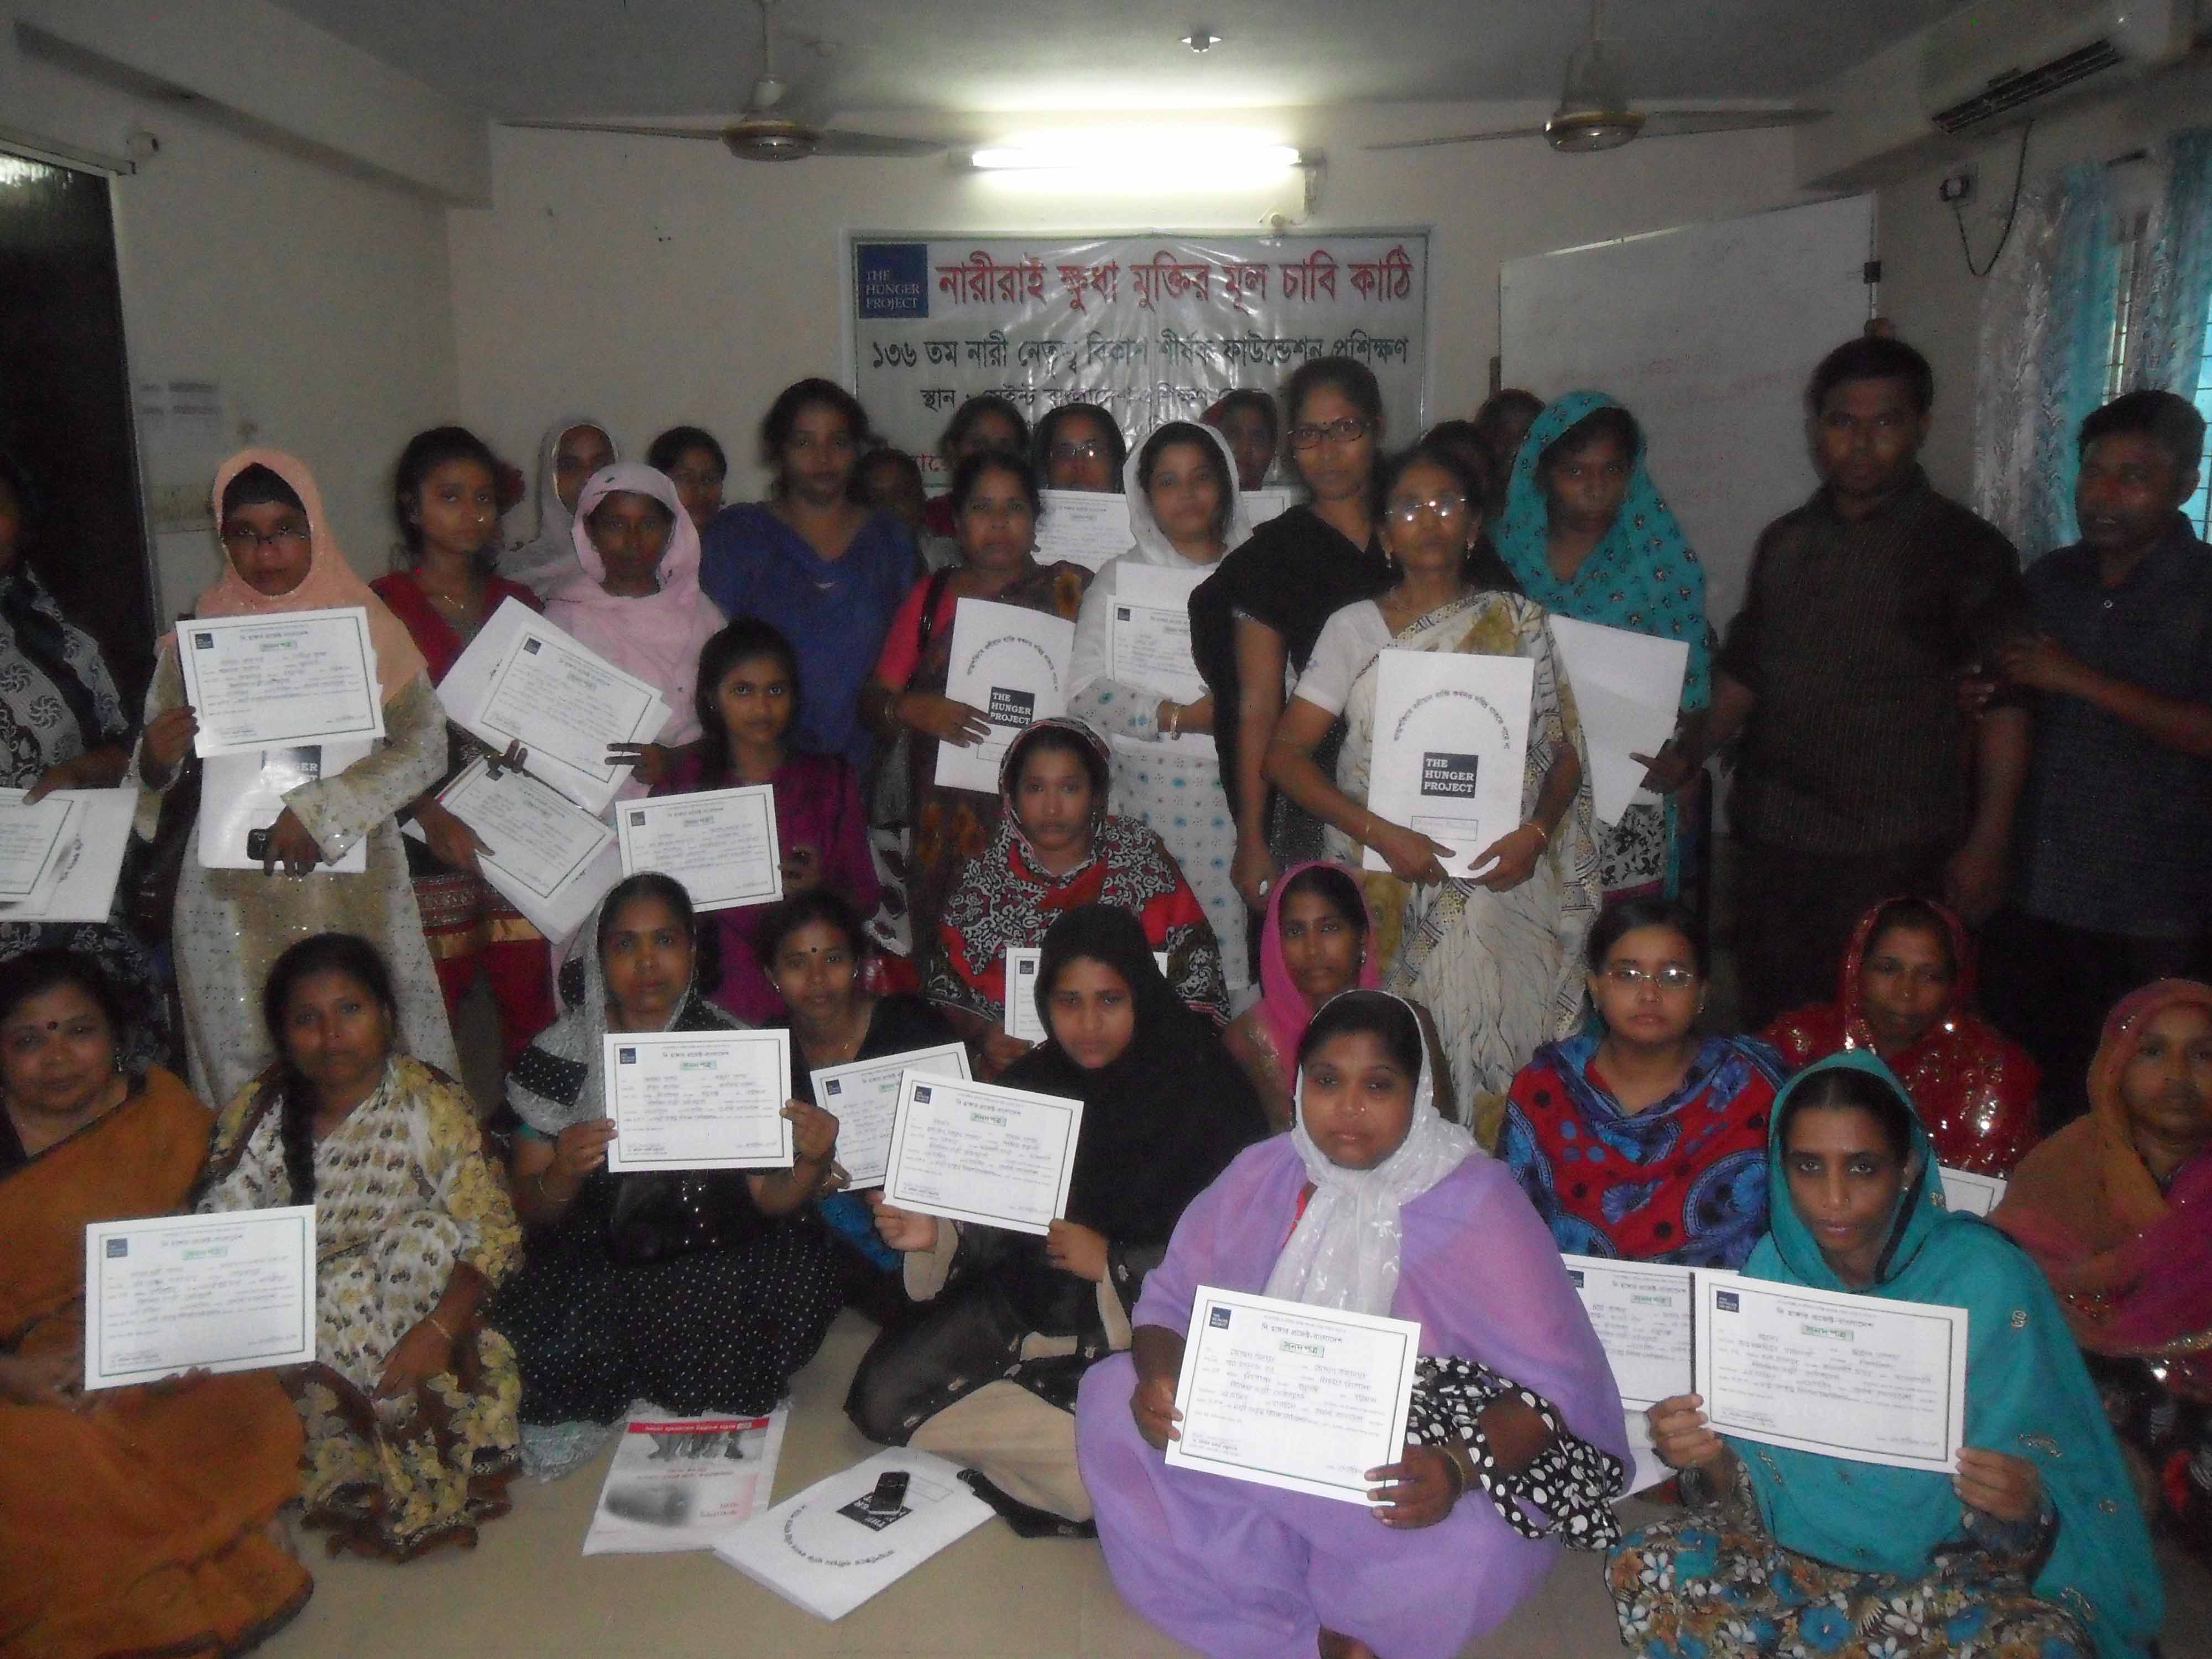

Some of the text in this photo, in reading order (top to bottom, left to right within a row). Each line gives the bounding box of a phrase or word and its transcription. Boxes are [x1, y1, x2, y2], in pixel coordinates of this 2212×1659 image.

[867, 269, 890, 281] THE
[935, 244, 1413, 316] নারীরাই ক্ষুধা মুক্তির মূল চাবি কাঠি
[865, 283, 920, 295] HUNGER
[866, 296, 919, 310] PROJECT
[923, 341, 958, 368] তম
[965, 329, 1009, 369] নারী
[1331, 328, 1410, 365] প্রশিক্ষণ
[920, 388, 956, 412] স্থান
[992, 692, 1011, 702] THE
[990, 702, 1032, 716] HUNGER
[990, 712, 1031, 724] PROJECT
[1426, 758, 1449, 769] THE
[1424, 769, 1474, 781] HUNGER
[1423, 781, 1474, 792] PROJECT
